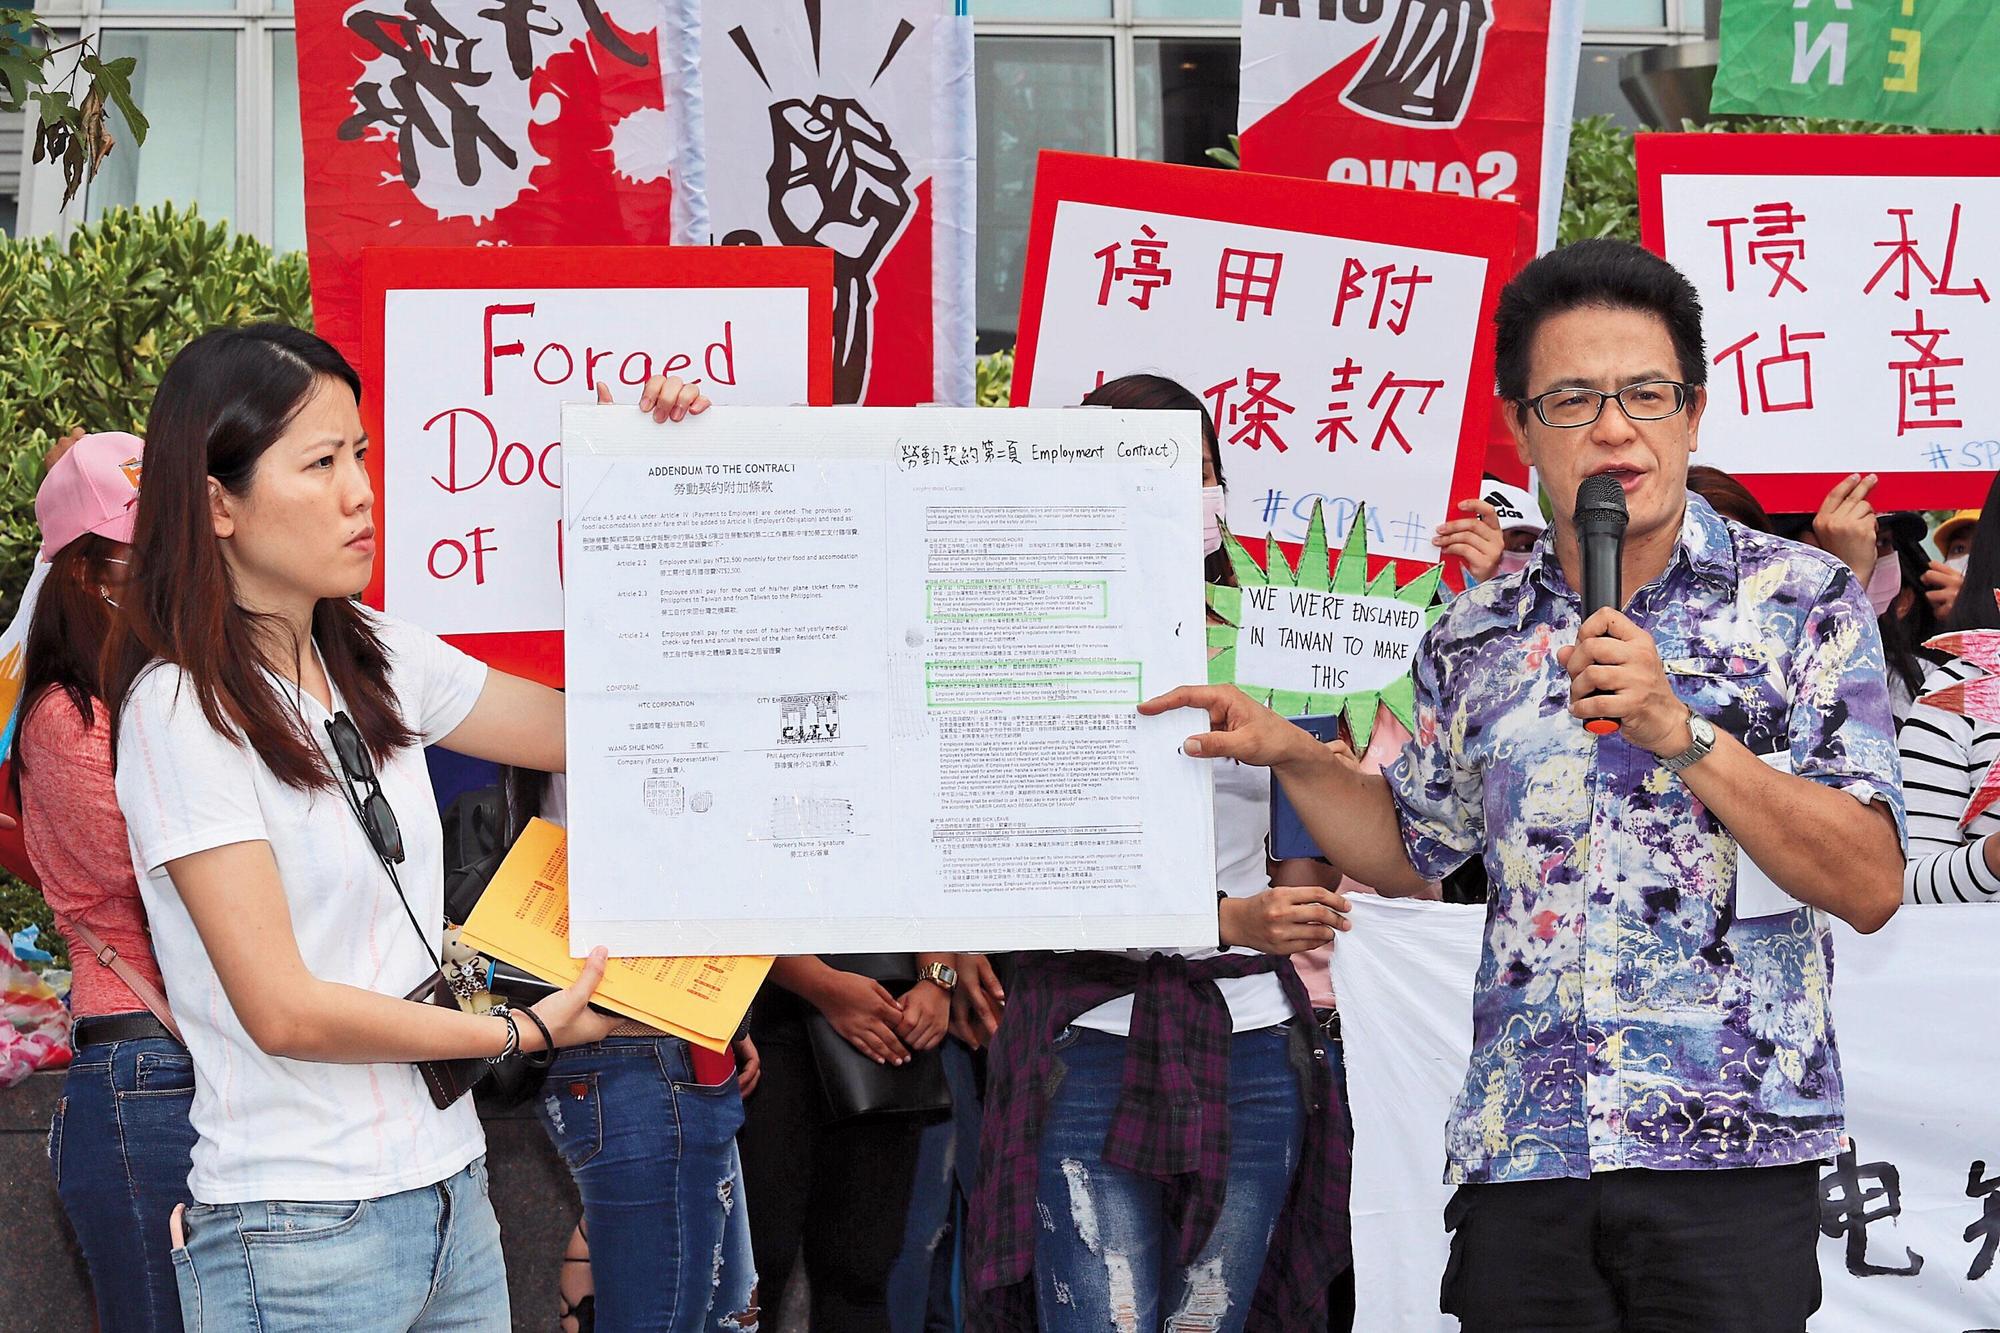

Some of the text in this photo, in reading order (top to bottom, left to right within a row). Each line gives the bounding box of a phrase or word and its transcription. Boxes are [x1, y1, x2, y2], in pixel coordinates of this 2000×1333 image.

[1083, 357, 1445, 459] 條款
[1032, 445, 1105, 465] Employment
[649, 463, 797, 477] ADDENDUM TO THE CONTRACT
[673, 480, 774, 496] 勞動契約附加條款
[815, 508, 842, 516] provision
[659, 558, 687, 567] Employee
[743, 556, 766, 564] monthly
[660, 589, 688, 597] Employee
[706, 588, 716, 596] pay
[793, 585, 808, 593] plane
[660, 596, 691, 604] Philippines
[1249, 587, 1419, 629] WE WERE ENSLAVED
[661, 630, 689, 638] Employee
[707, 629, 717, 637] pay
[1251, 626, 1409, 661] IN TAIWAN TO MAKE
[1311, 664, 1349, 689] THIS
[652, 700, 695, 708] CORPORATION
